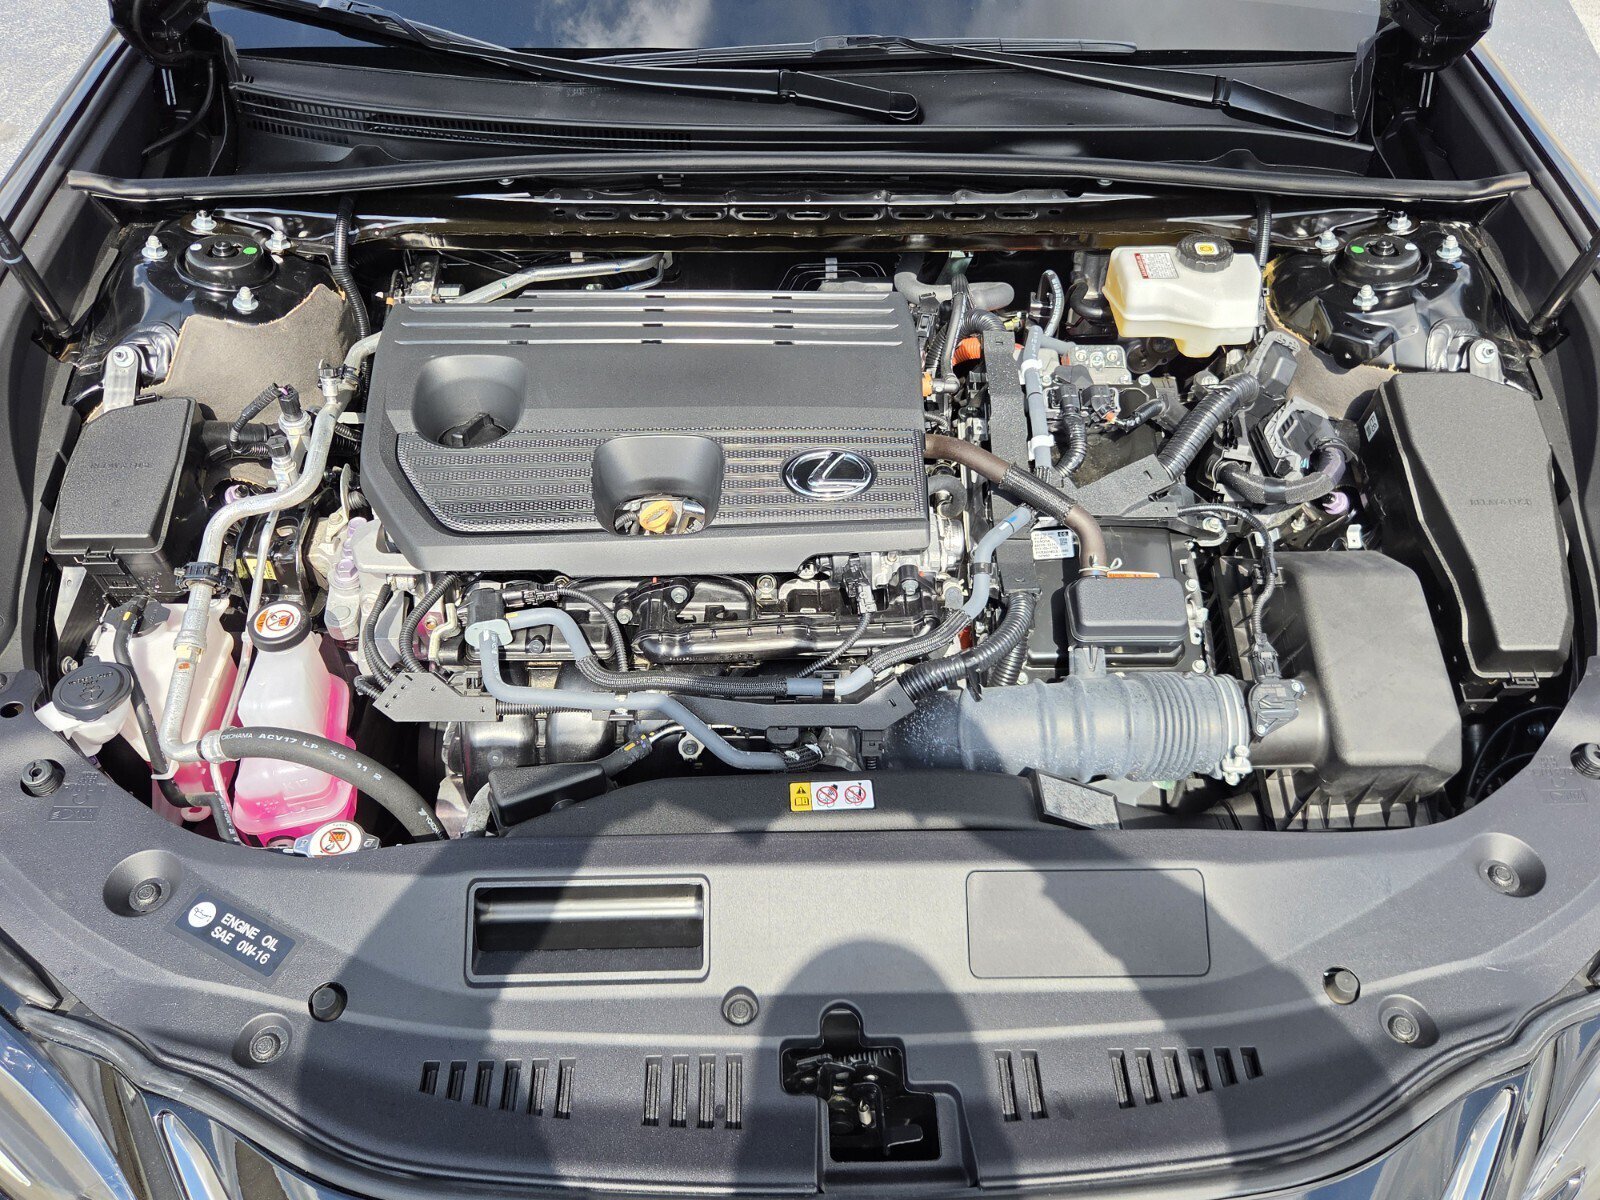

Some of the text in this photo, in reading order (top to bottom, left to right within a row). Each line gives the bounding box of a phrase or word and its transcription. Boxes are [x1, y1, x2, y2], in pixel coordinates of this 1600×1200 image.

[220, 732, 253, 741] OKOHAMA
[258, 733, 298, 744] ACV17
[302, 741, 319, 749] LP
[211, 926, 270, 965] SAE 0W-16
[221, 913, 279, 953] ENGINE OIL
